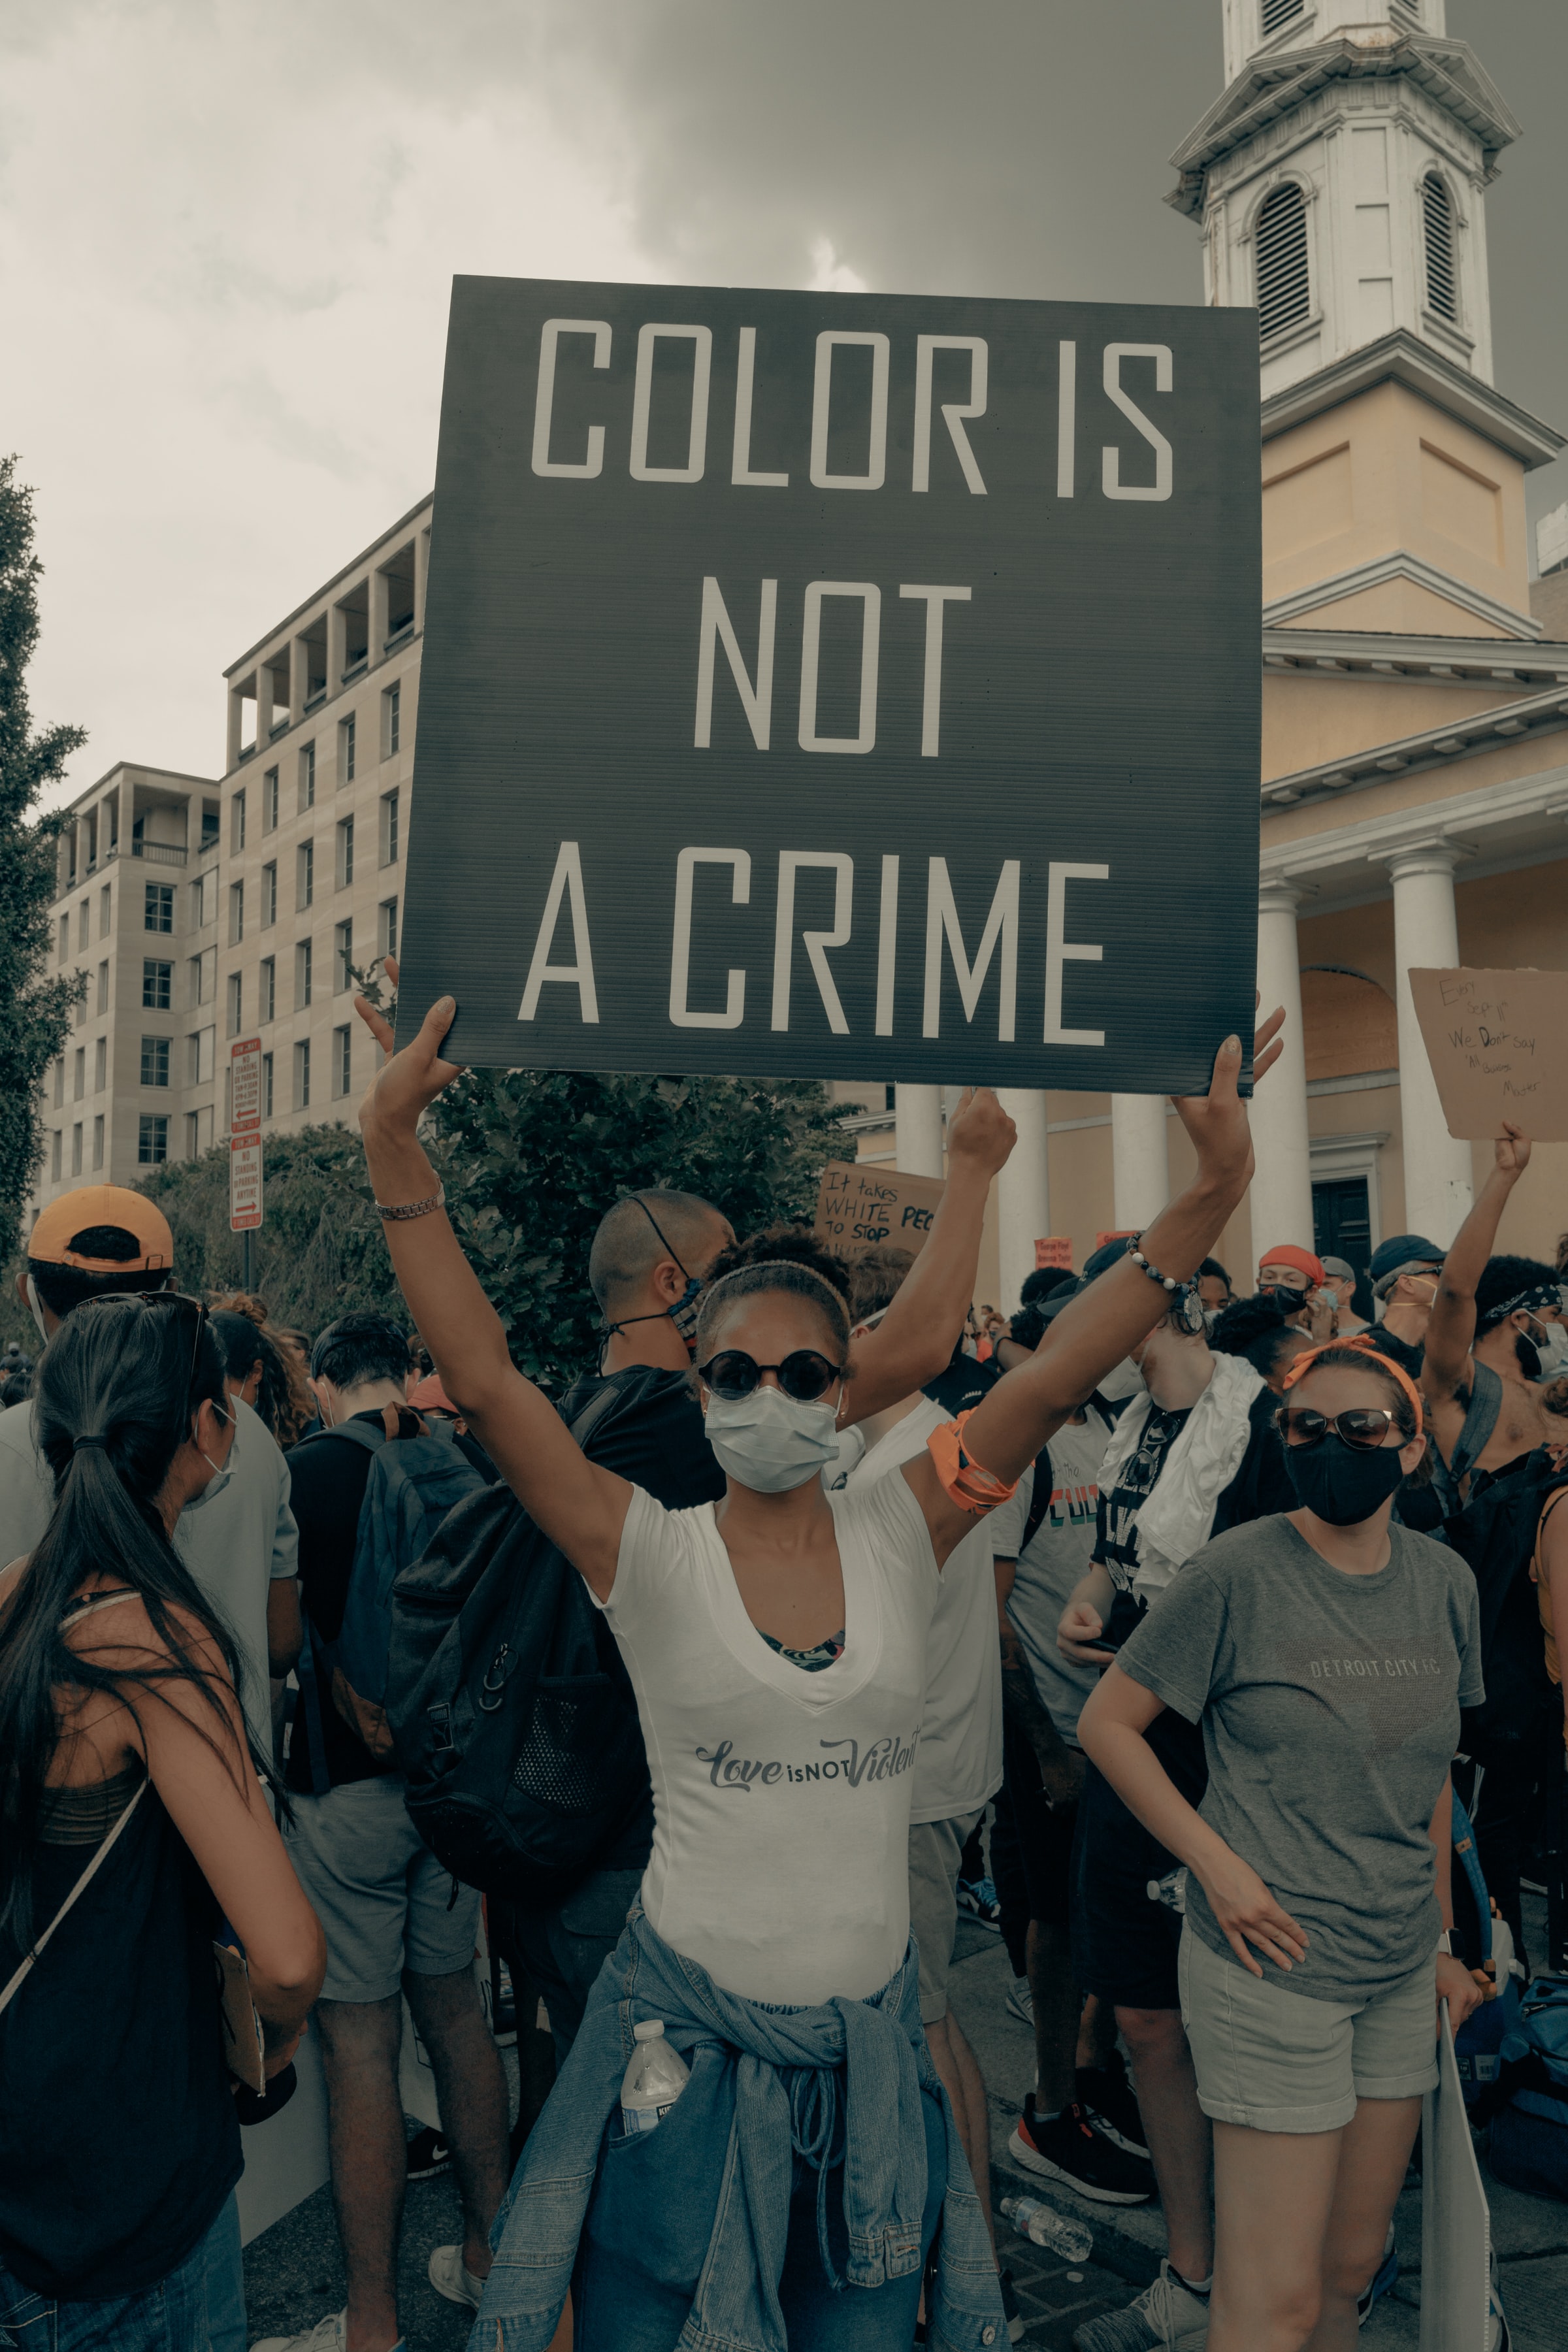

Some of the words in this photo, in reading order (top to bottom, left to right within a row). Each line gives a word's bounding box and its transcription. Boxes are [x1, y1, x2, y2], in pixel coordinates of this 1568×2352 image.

[532, 319, 988, 495] COLOR
[1058, 341, 1172, 501] IS
[694, 577, 972, 757] NOT
[517, 841, 599, 1023] A
[670, 847, 1109, 1045] CRIME
[1448, 1026, 1477, 1048] We
[1478, 1026, 1511, 1047] Don't
[242, 1055, 250, 1064] NO
[236, 1062, 257, 1075] STANDING
[235, 1075, 240, 1084] OR
[241, 1071, 258, 1083] PARKING
[242, 1150, 250, 1161] NO
[235, 1162, 257, 1175] STANDING
[238, 1175, 259, 1188] PARKING
[826, 1171, 850, 1193] It
[237, 1187, 257, 1200] ANYTIME
[826, 1196, 893, 1222] WHITE
[825, 1220, 844, 1237] TO
[851, 1223, 890, 1244] STOP
[1040, 1242, 1056, 1252] George
[1058, 1242, 1069, 1251] Floyd
[1058, 1254, 1071, 1264] Taylor
[1310, 1659, 1380, 1678] DETROIT
[1384, 1659, 1418, 1676] CITY
[1422, 1658, 1441, 1675] FC
[430, 1708, 448, 1720] PUMA
[695, 1740, 783, 1793] Love
[820, 1725, 921, 1788] Violent
